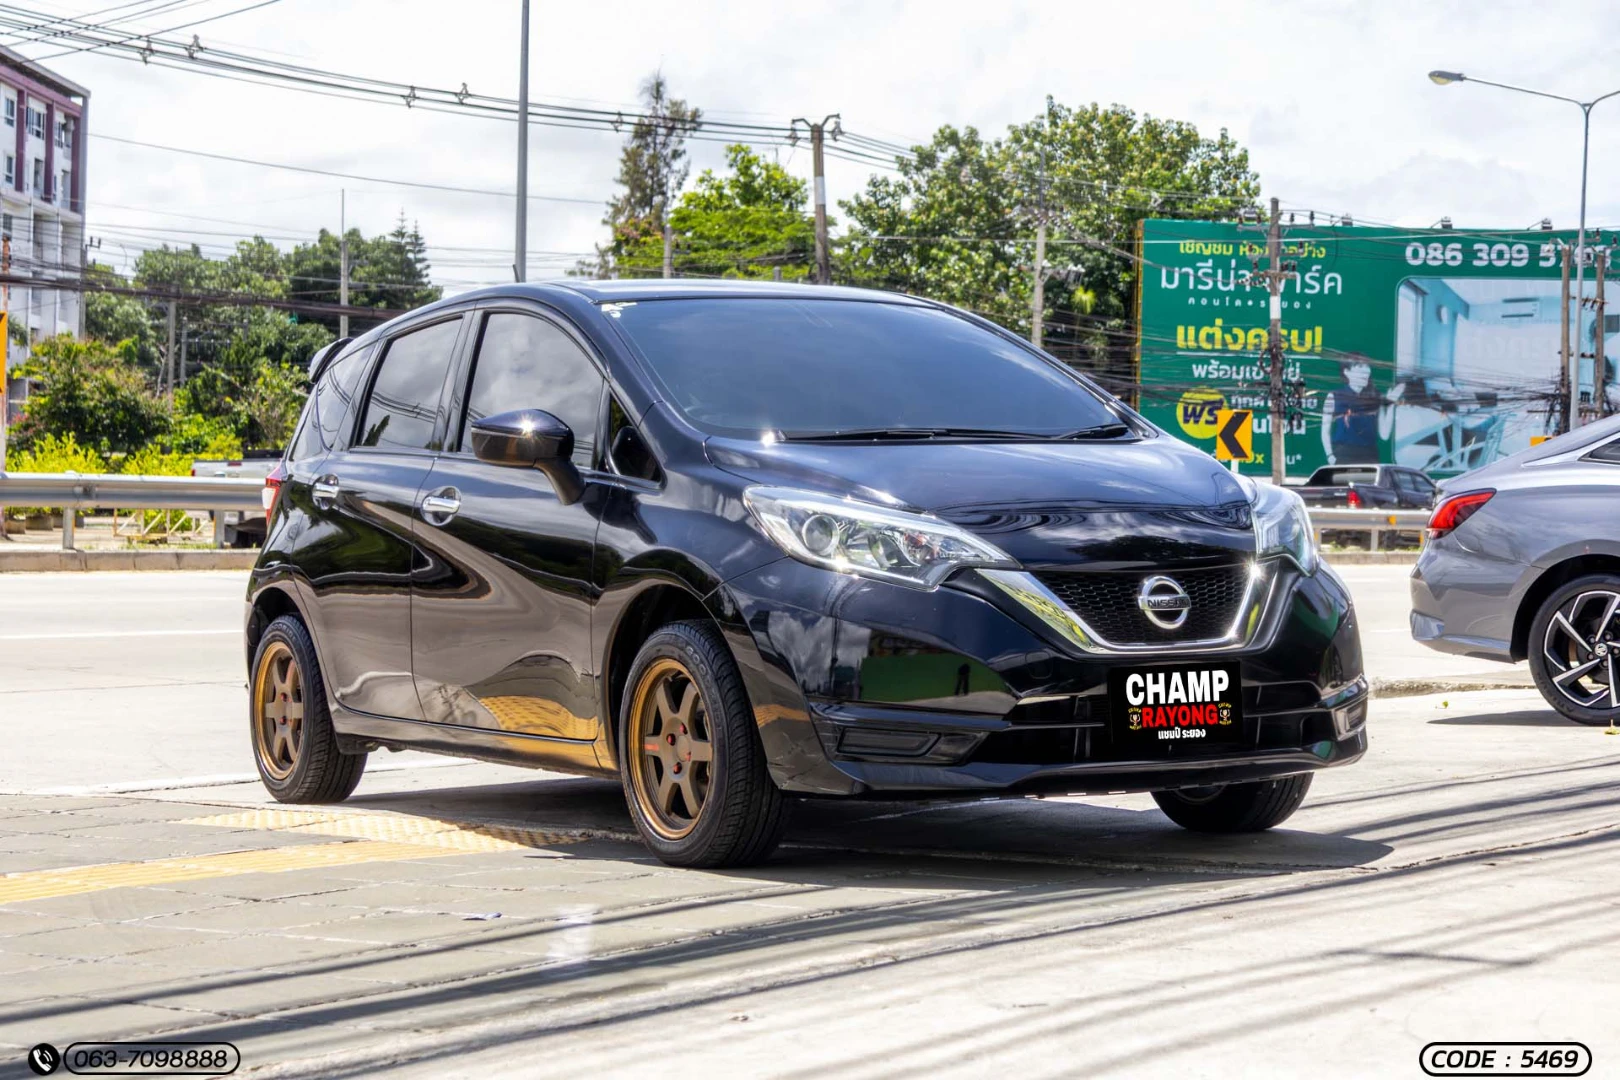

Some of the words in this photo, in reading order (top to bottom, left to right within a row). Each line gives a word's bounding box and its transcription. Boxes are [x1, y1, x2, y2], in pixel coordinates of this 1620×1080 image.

[1180, 240, 1233, 256] เชิญชม
[1405, 242, 1463, 267] 086
[1472, 243, 1529, 267] 309
[1259, 299, 1312, 310] รยอง
[1147, 598, 1189, 608] NISSAN
[1126, 670, 1229, 706] CHAMP
[1142, 704, 1218, 728] RAYONG
[1181, 728, 1206, 739] ระยอง
